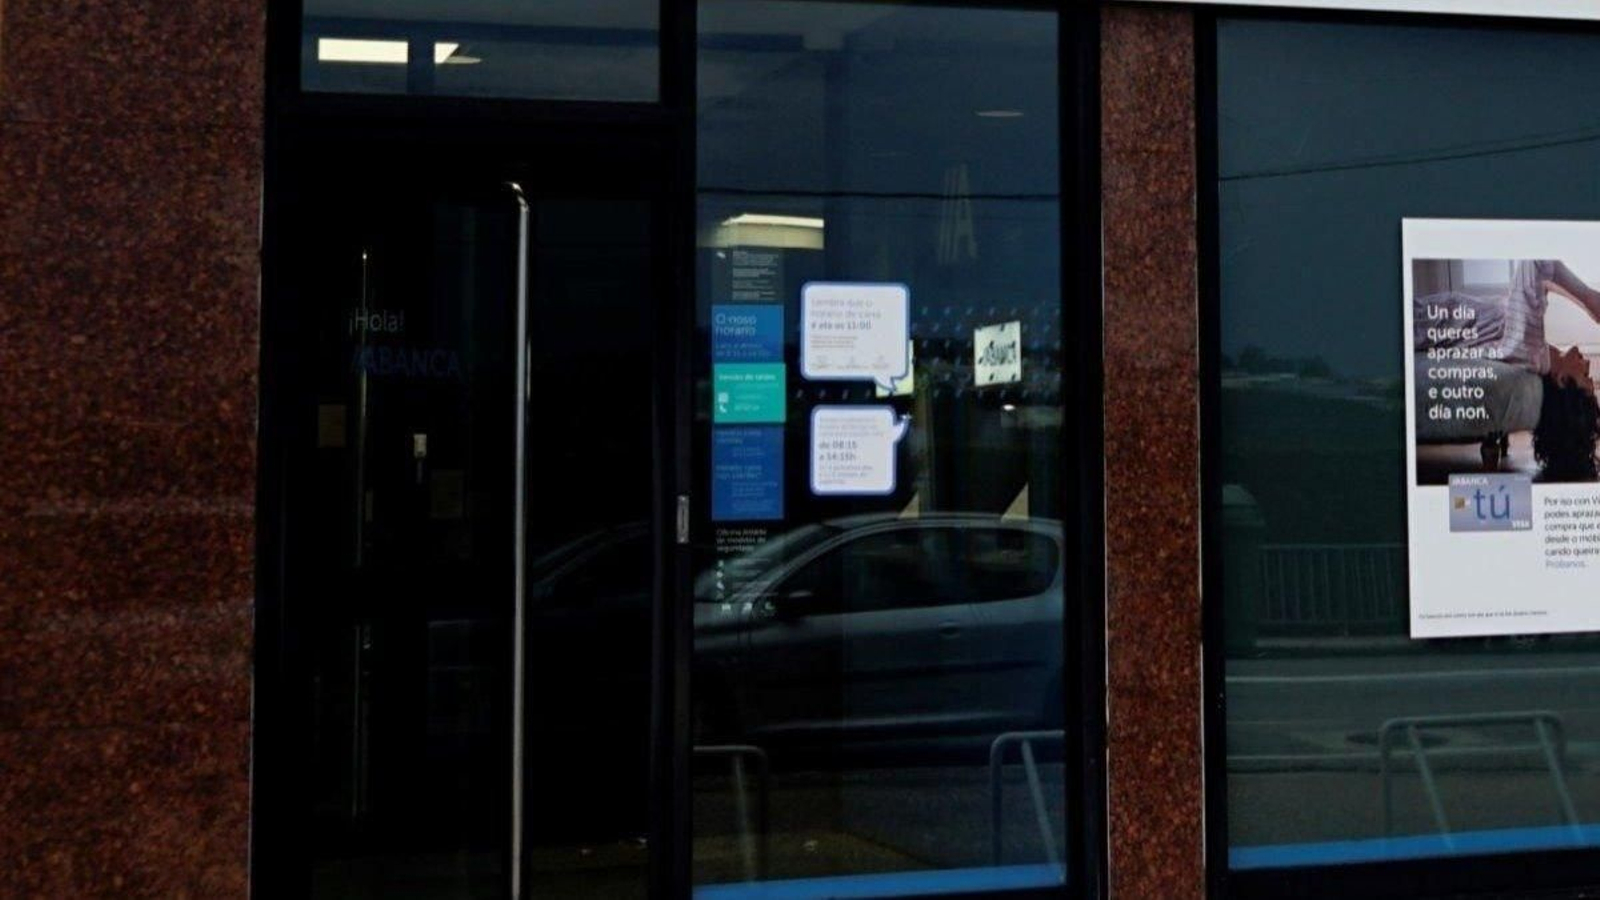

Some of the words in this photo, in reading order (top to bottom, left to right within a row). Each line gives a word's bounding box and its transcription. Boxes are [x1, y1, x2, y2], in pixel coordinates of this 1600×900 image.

[1427, 305, 1449, 320] Un
[1427, 327, 1478, 341] queres
[1427, 348, 1484, 363] aprazar
[1488, 348, 1504, 360] as
[1428, 367, 1498, 382] compras,
[1428, 388, 1438, 400] e
[1442, 387, 1484, 400] outro
[1456, 406, 1490, 420] non.
[1473, 484, 1510, 521] tú
